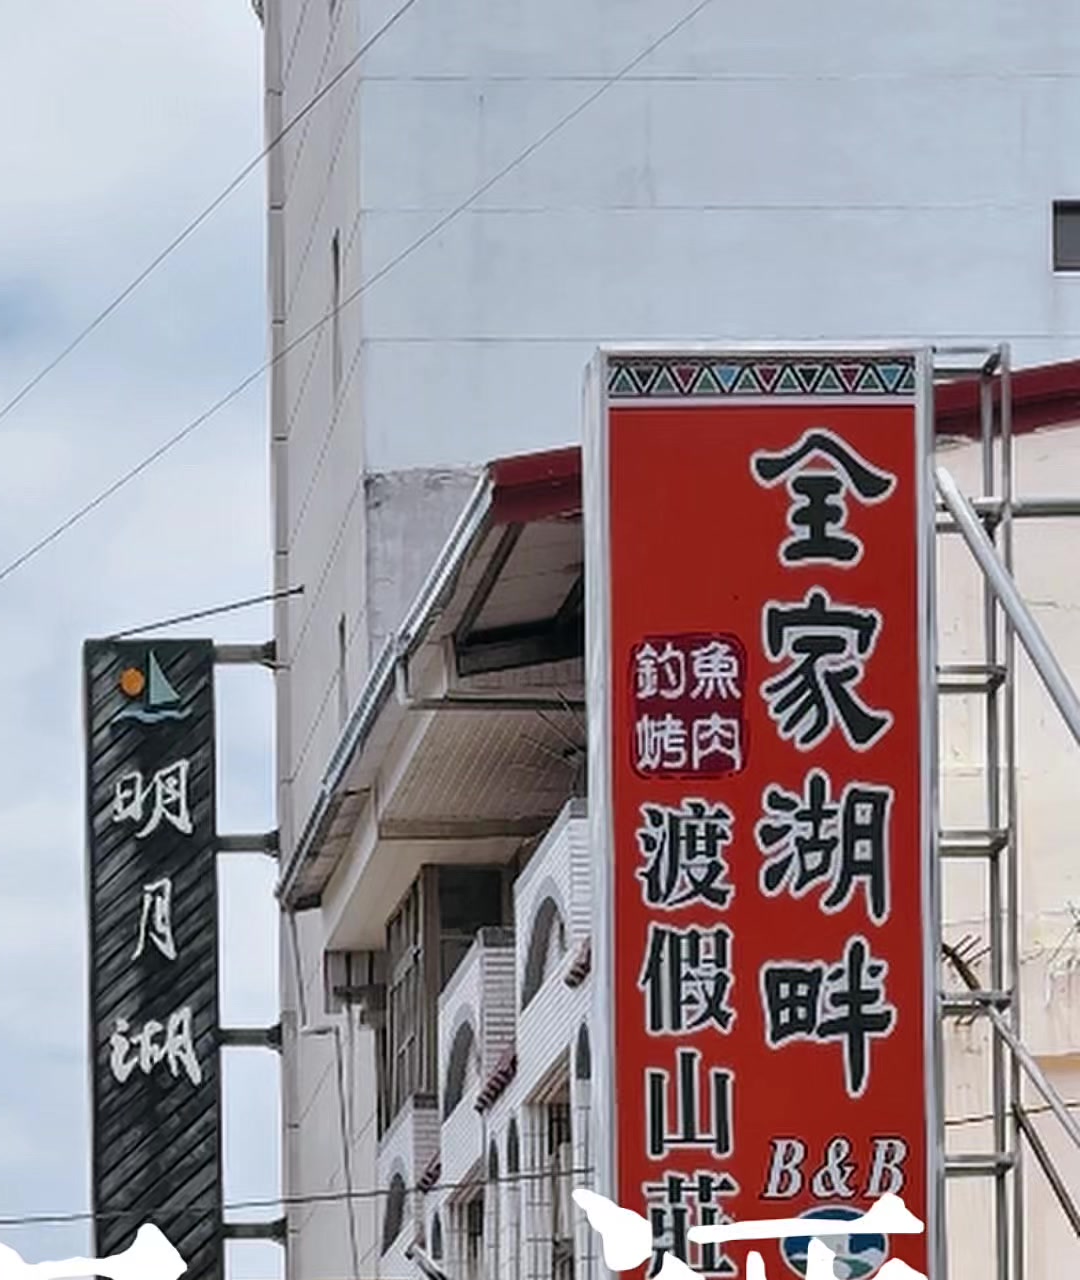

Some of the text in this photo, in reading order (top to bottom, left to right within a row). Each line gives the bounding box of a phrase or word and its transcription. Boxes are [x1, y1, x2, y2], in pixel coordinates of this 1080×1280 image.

[636, 642, 742, 700] 釣魚
[636, 714, 742, 772] 烤肉
[749, 428, 897, 1099] 全家湖畔
[108, 758, 202, 1086] 明月湖
[635, 798, 739, 1280] 渡假山莊
[762, 1137, 907, 1200] B&B
